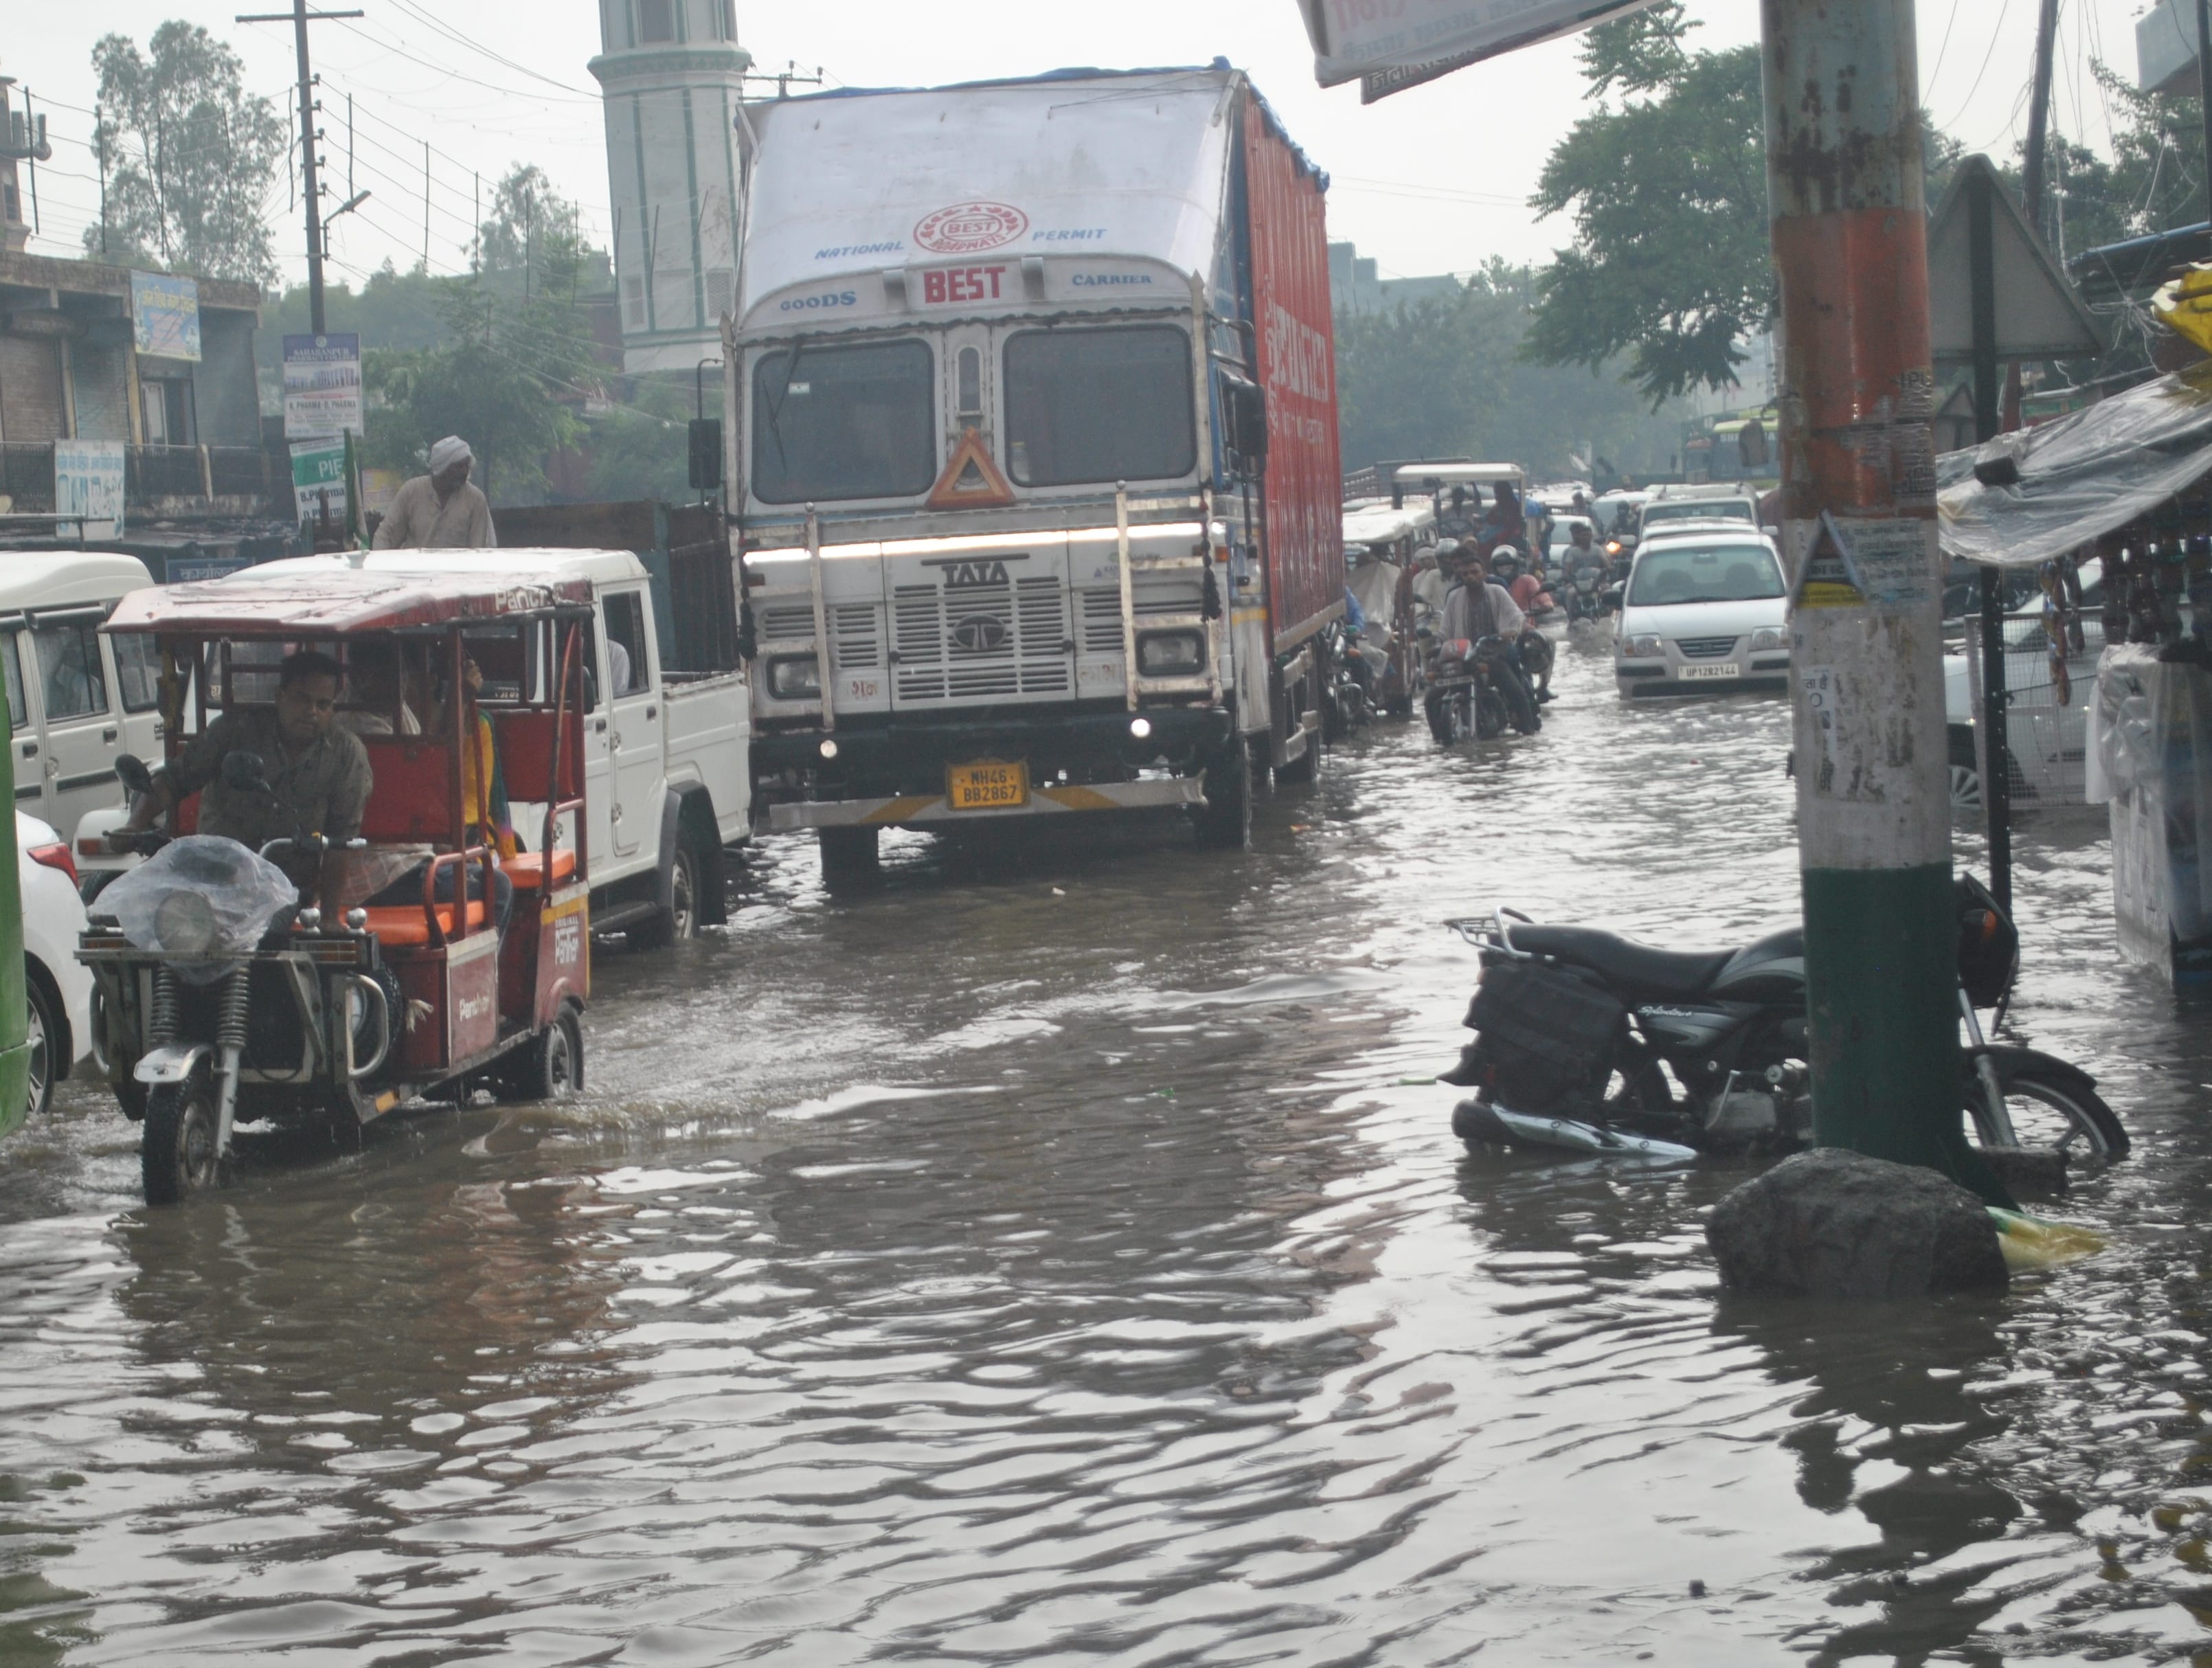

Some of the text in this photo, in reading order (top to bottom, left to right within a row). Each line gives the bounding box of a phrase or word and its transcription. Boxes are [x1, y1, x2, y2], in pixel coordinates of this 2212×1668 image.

[947, 221, 995, 234] BEST
[814, 228, 1108, 260] NATIONAL PERMIT
[928, 234, 1006, 251] ROADWAYS
[780, 273, 1153, 311] GOODS CARRIER
[923, 265, 1006, 304] BEST
[318, 458, 345, 478] PIE
[941, 561, 1010, 585] TATA
[971, 769, 1007, 785] MH46
[963, 785, 1017, 802] BB2867
[554, 915, 578, 928] ORIGINAL
